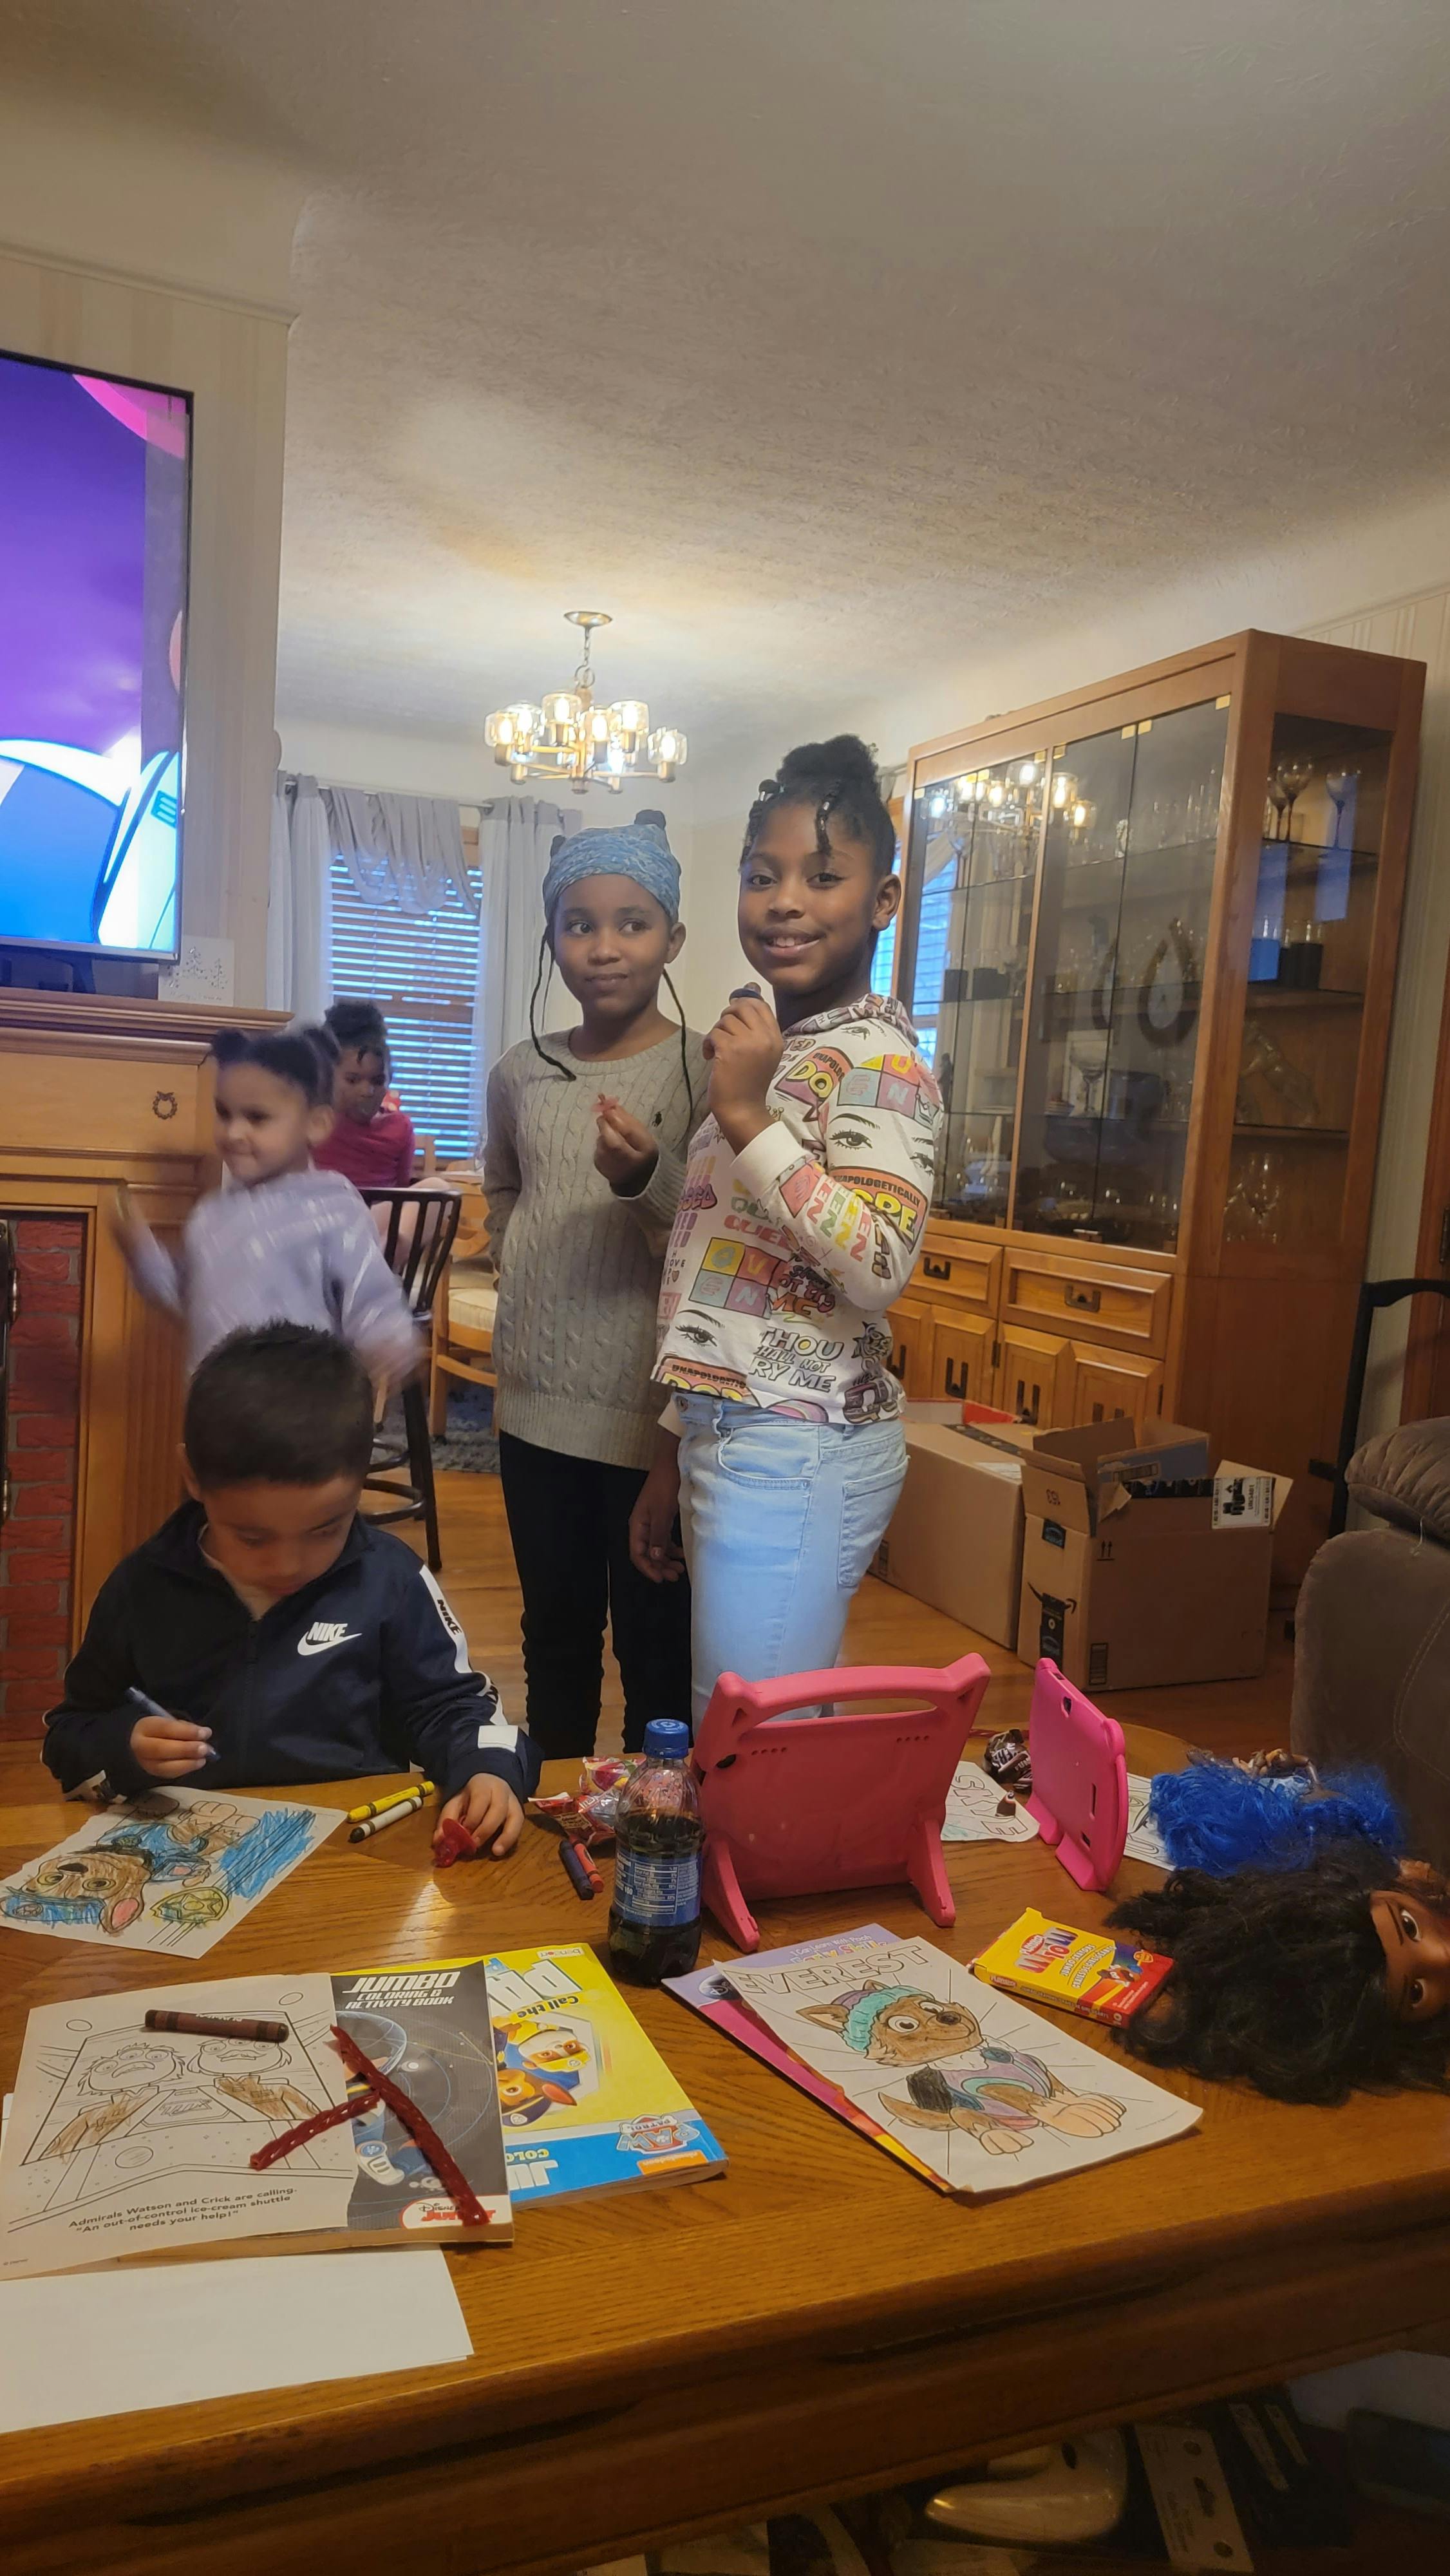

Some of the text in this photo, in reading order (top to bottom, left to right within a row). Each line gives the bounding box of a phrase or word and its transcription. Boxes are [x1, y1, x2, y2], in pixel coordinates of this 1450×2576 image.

[800, 1358, 831, 1373] NOT
[788, 1369, 836, 1393] ME
[437, 1599, 462, 1635] NIKE
[307, 1622, 348, 1642] NIKE
[811, 1942, 833, 1951] Learn
[833, 1937, 849, 1946] With
[849, 1935, 872, 1944] Pooh
[1071, 1943, 1096, 1962] CRAYONS
[722, 1945, 929, 1994] EVEREST
[342, 1971, 461, 1993] JUMBO
[344, 1996, 455, 2009] ACTIVITY BOOK
[356, 1990, 429, 2002] COLORING
[517, 1996, 579, 2018] Call the
[630, 2119, 670, 2131] PATROL
[616, 2123, 701, 2150] PAW
[68, 2187, 297, 2228] Admirals Watson and Crick are calling.
[103, 2208, 187, 2228] out-of-control
[190, 2202, 247, 2213] ice-cream
[250, 2195, 291, 2207] shuttle
[129, 2219, 166, 2231] needs
[169, 2214, 197, 2226] your
